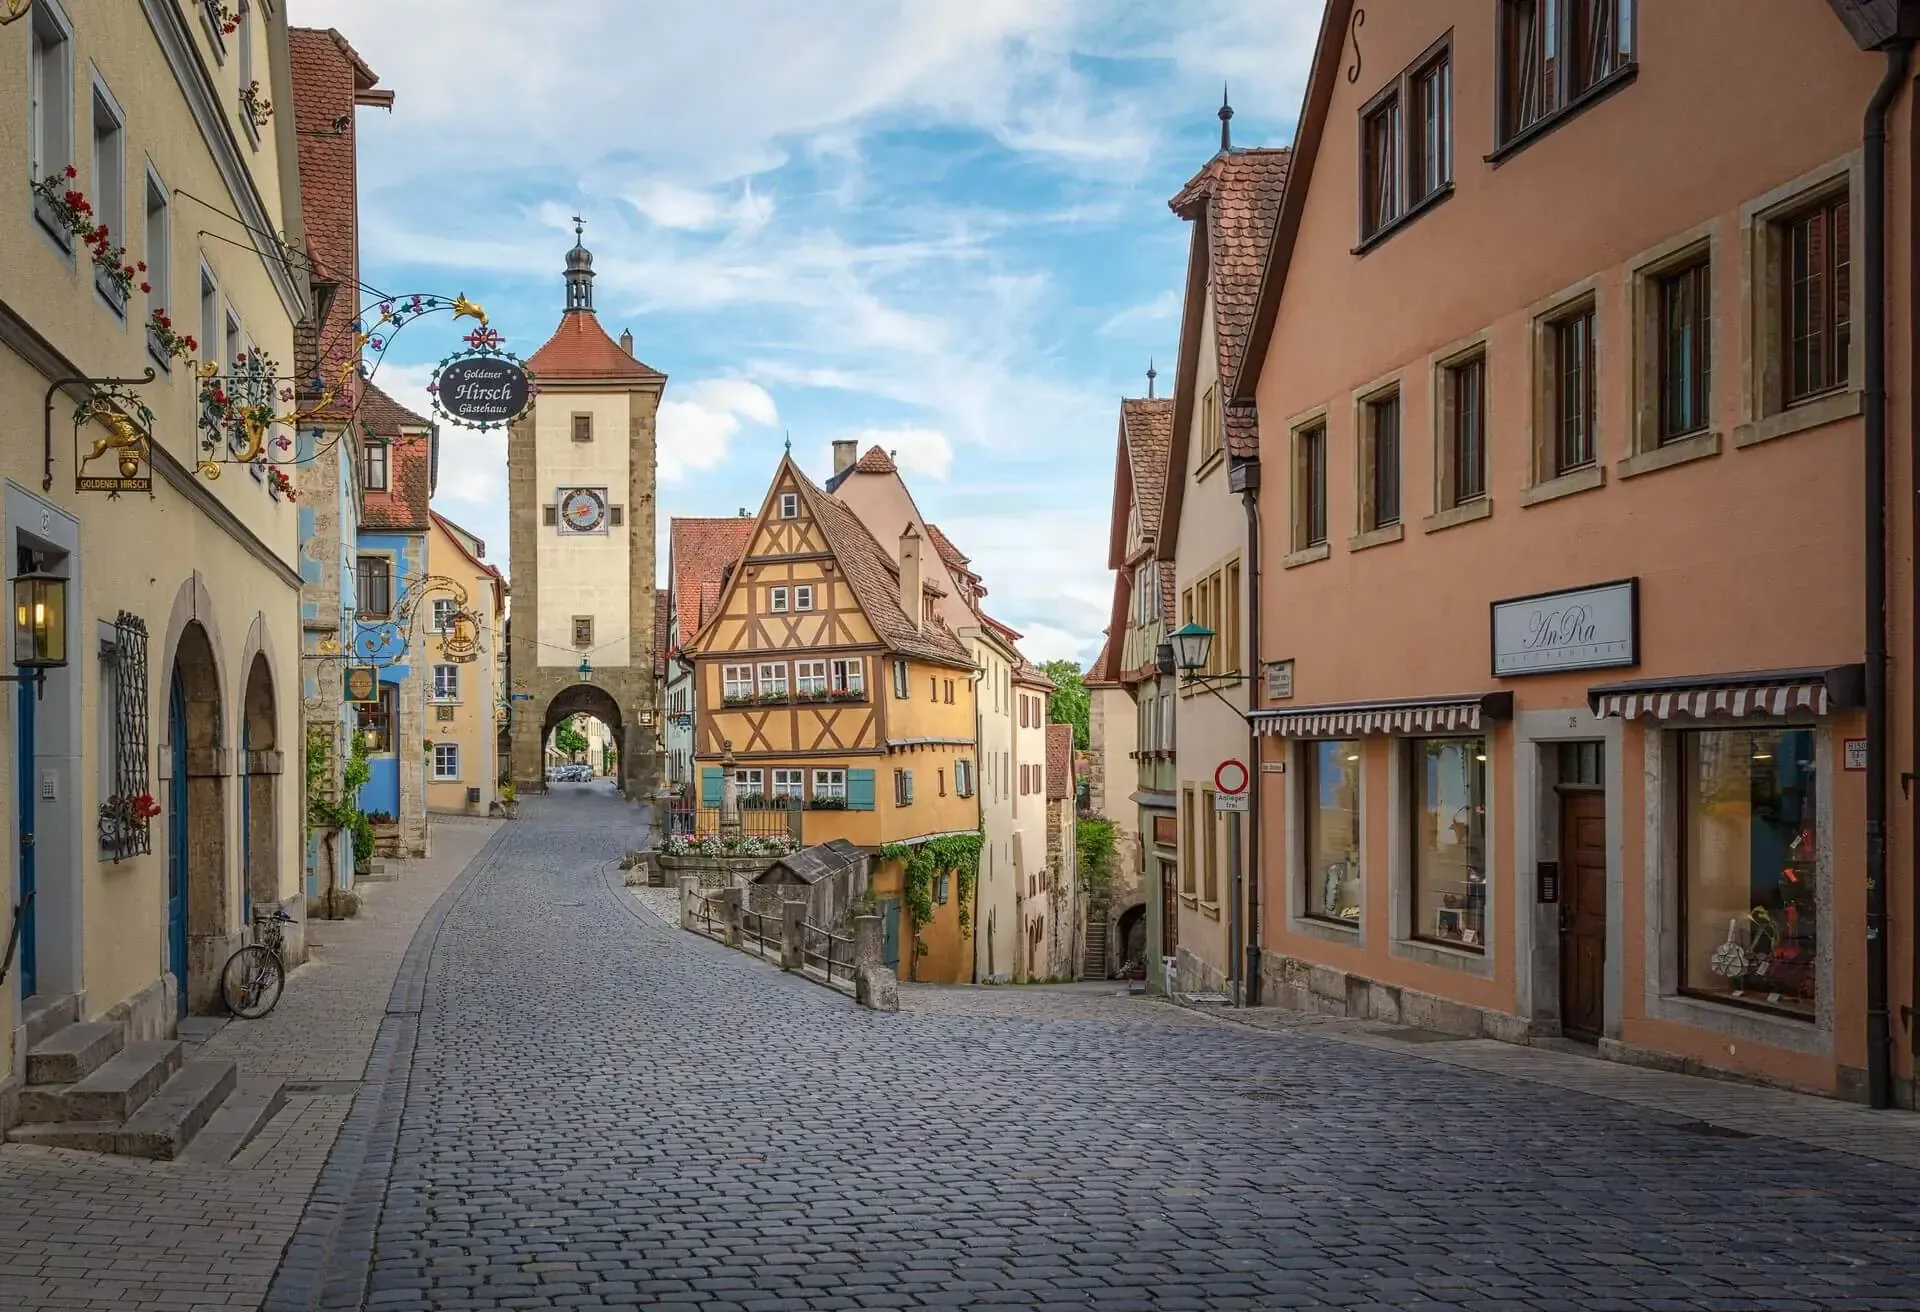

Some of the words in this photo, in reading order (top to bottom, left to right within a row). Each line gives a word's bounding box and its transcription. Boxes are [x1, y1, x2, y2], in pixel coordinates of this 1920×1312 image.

[464, 369, 503, 381] Goldener
[454, 382, 513, 400] Hirsch
[459, 402, 508, 416] Gästehaus
[80, 479, 118, 489] GOLDENER
[120, 479, 148, 489] HIRSCH
[1523, 604, 1596, 649] AnRa
[1218, 794, 1247, 804] Anlieger
[1225, 801, 1238, 809] frei
